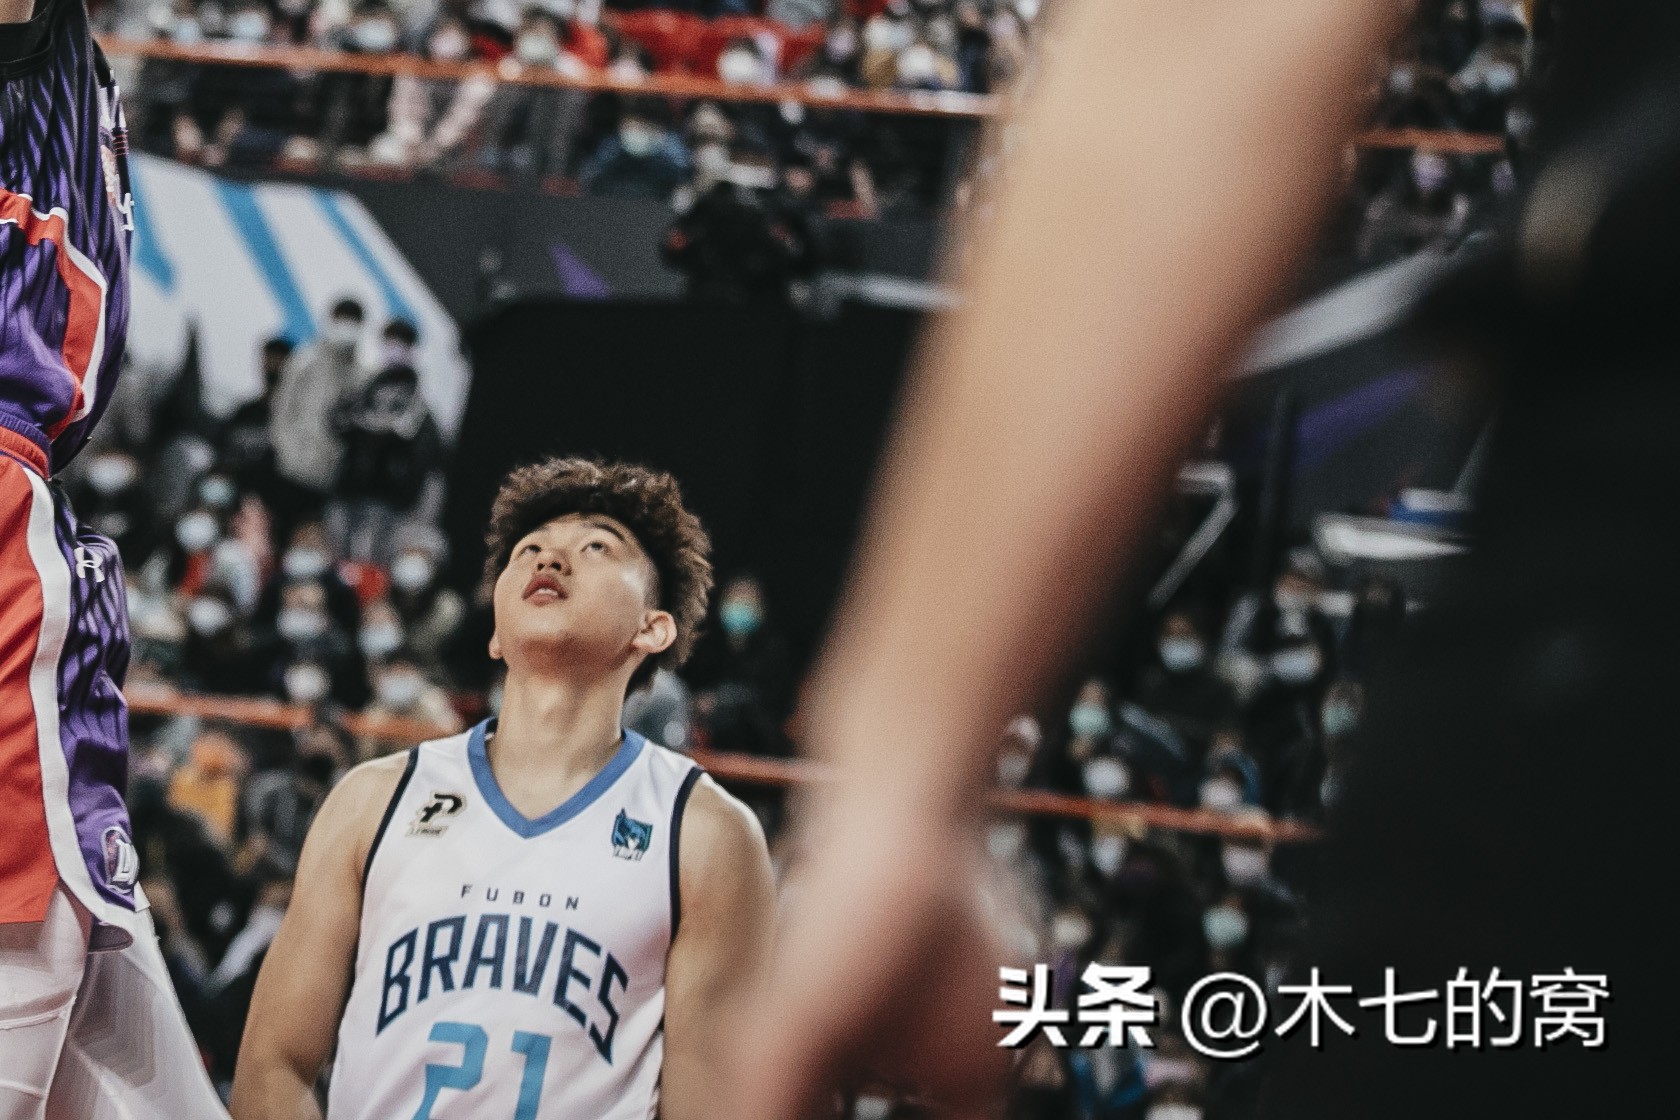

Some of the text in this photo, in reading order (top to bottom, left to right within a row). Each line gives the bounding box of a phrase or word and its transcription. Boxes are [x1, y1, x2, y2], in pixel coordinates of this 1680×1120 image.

[460, 884, 580, 911] FUBON
[376, 913, 629, 1066] BRAVES
[411, 1021, 552, 1120] 21
